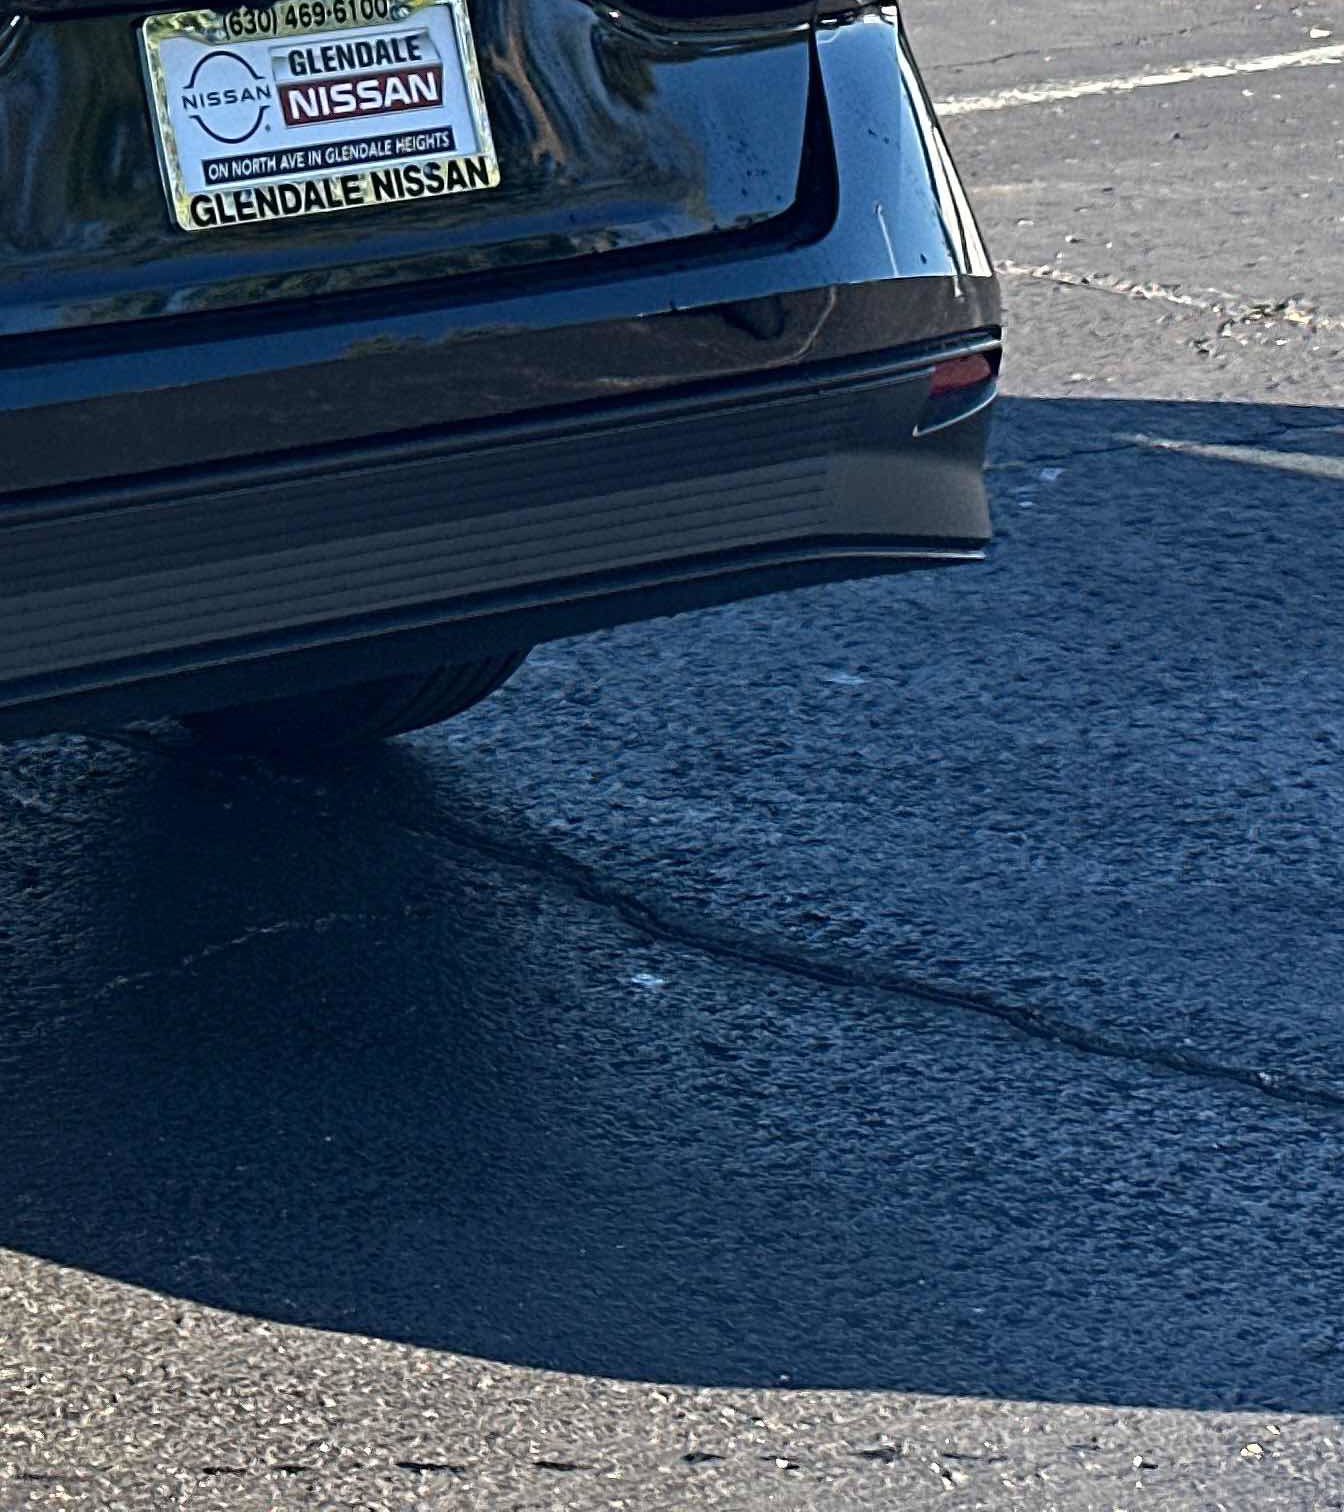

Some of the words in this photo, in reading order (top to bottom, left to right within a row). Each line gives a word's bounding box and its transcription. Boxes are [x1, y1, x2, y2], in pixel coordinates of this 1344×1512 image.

[223, 7, 278, 40] (630)
[288, 36, 422, 76] GLENDALE
[180, 84, 272, 111] NISSAN
[288, 71, 439, 120] NISSAN
[208, 162, 229, 181] ON
[232, 155, 277, 178] NORTH
[280, 151, 306, 170] AVE
[308, 149, 322, 166] IN
[325, 139, 393, 164] GLENDALE
[395, 131, 450, 153] HEIGHTS
[190, 174, 363, 228] GLENDALE
[369, 155, 491, 201] NISSAN
